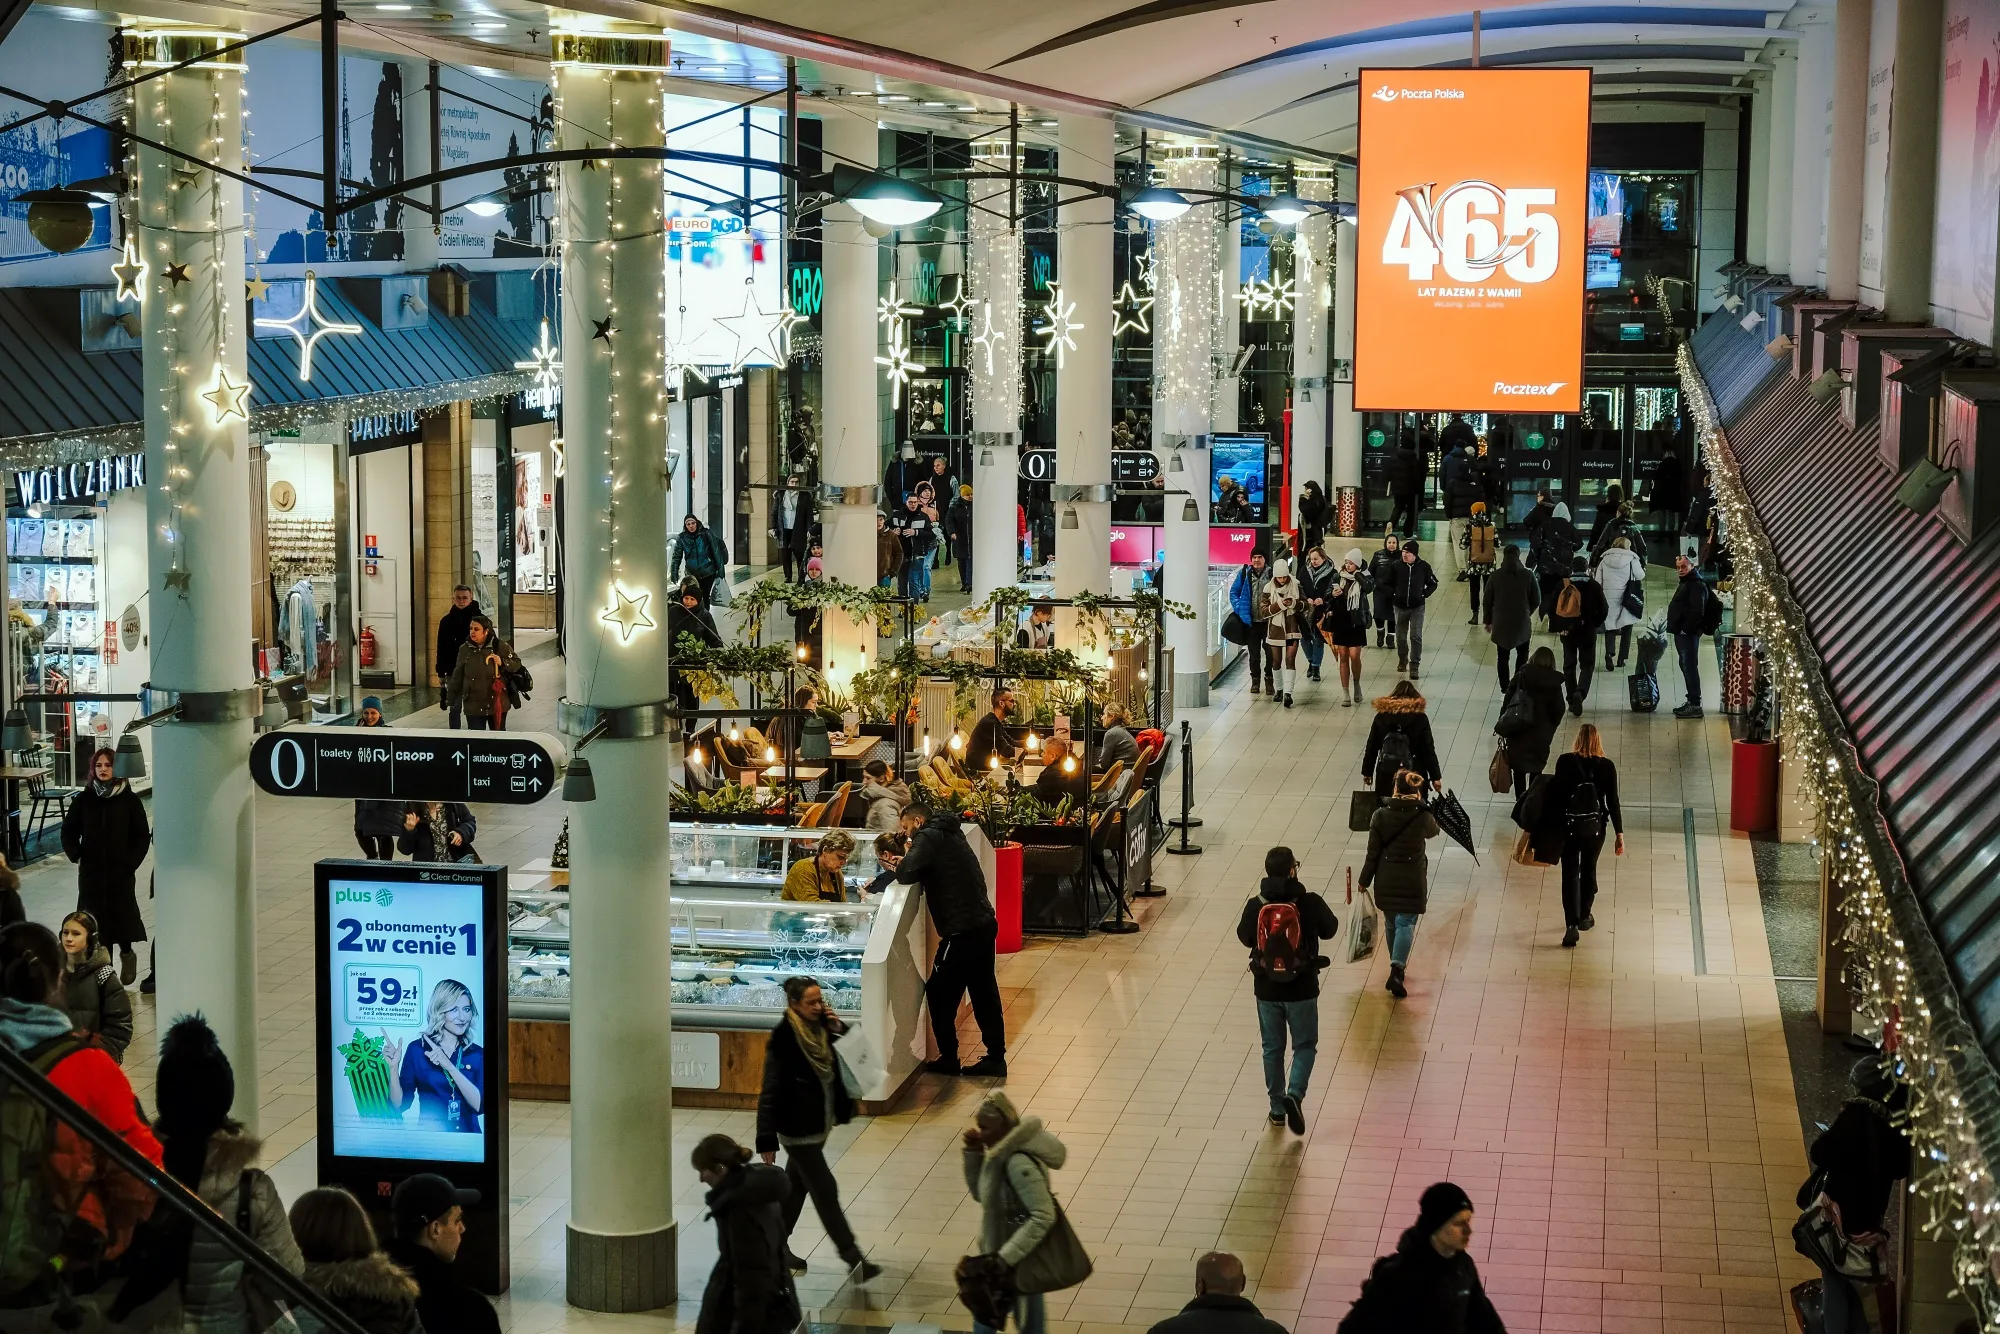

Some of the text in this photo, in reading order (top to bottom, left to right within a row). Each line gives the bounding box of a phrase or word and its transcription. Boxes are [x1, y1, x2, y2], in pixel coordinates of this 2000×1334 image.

[1401, 88, 1464, 98] Poczta Polska
[674, 220, 708, 228] EURO
[712, 218, 742, 232] AGD
[1382, 187, 1559, 283] 465
[1418, 288, 1436, 296] LAT
[1438, 288, 1475, 296] RAZEM
[1478, 288, 1484, 296] Z
[1260, 342, 1272, 350] ul.
[1493, 382, 1548, 395] Pocztex
[1028, 454, 1045, 478] 0
[1542, 459, 1550, 470] 0
[1110, 530, 1126, 542] glo
[123, 622, 139, 633] -40%
[320, 748, 352, 760] toalety
[396, 752, 434, 762] CROPP
[472, 754, 508, 765] autobusy
[272, 739, 304, 789] 0
[474, 777, 490, 786] taxi
[452, 874, 482, 882] Channel
[336, 888, 371, 904] plus
[337, 918, 457, 952] 2 abonamenty
[366, 924, 476, 956] w cenie 1
[357, 977, 417, 1005] 59 zł
